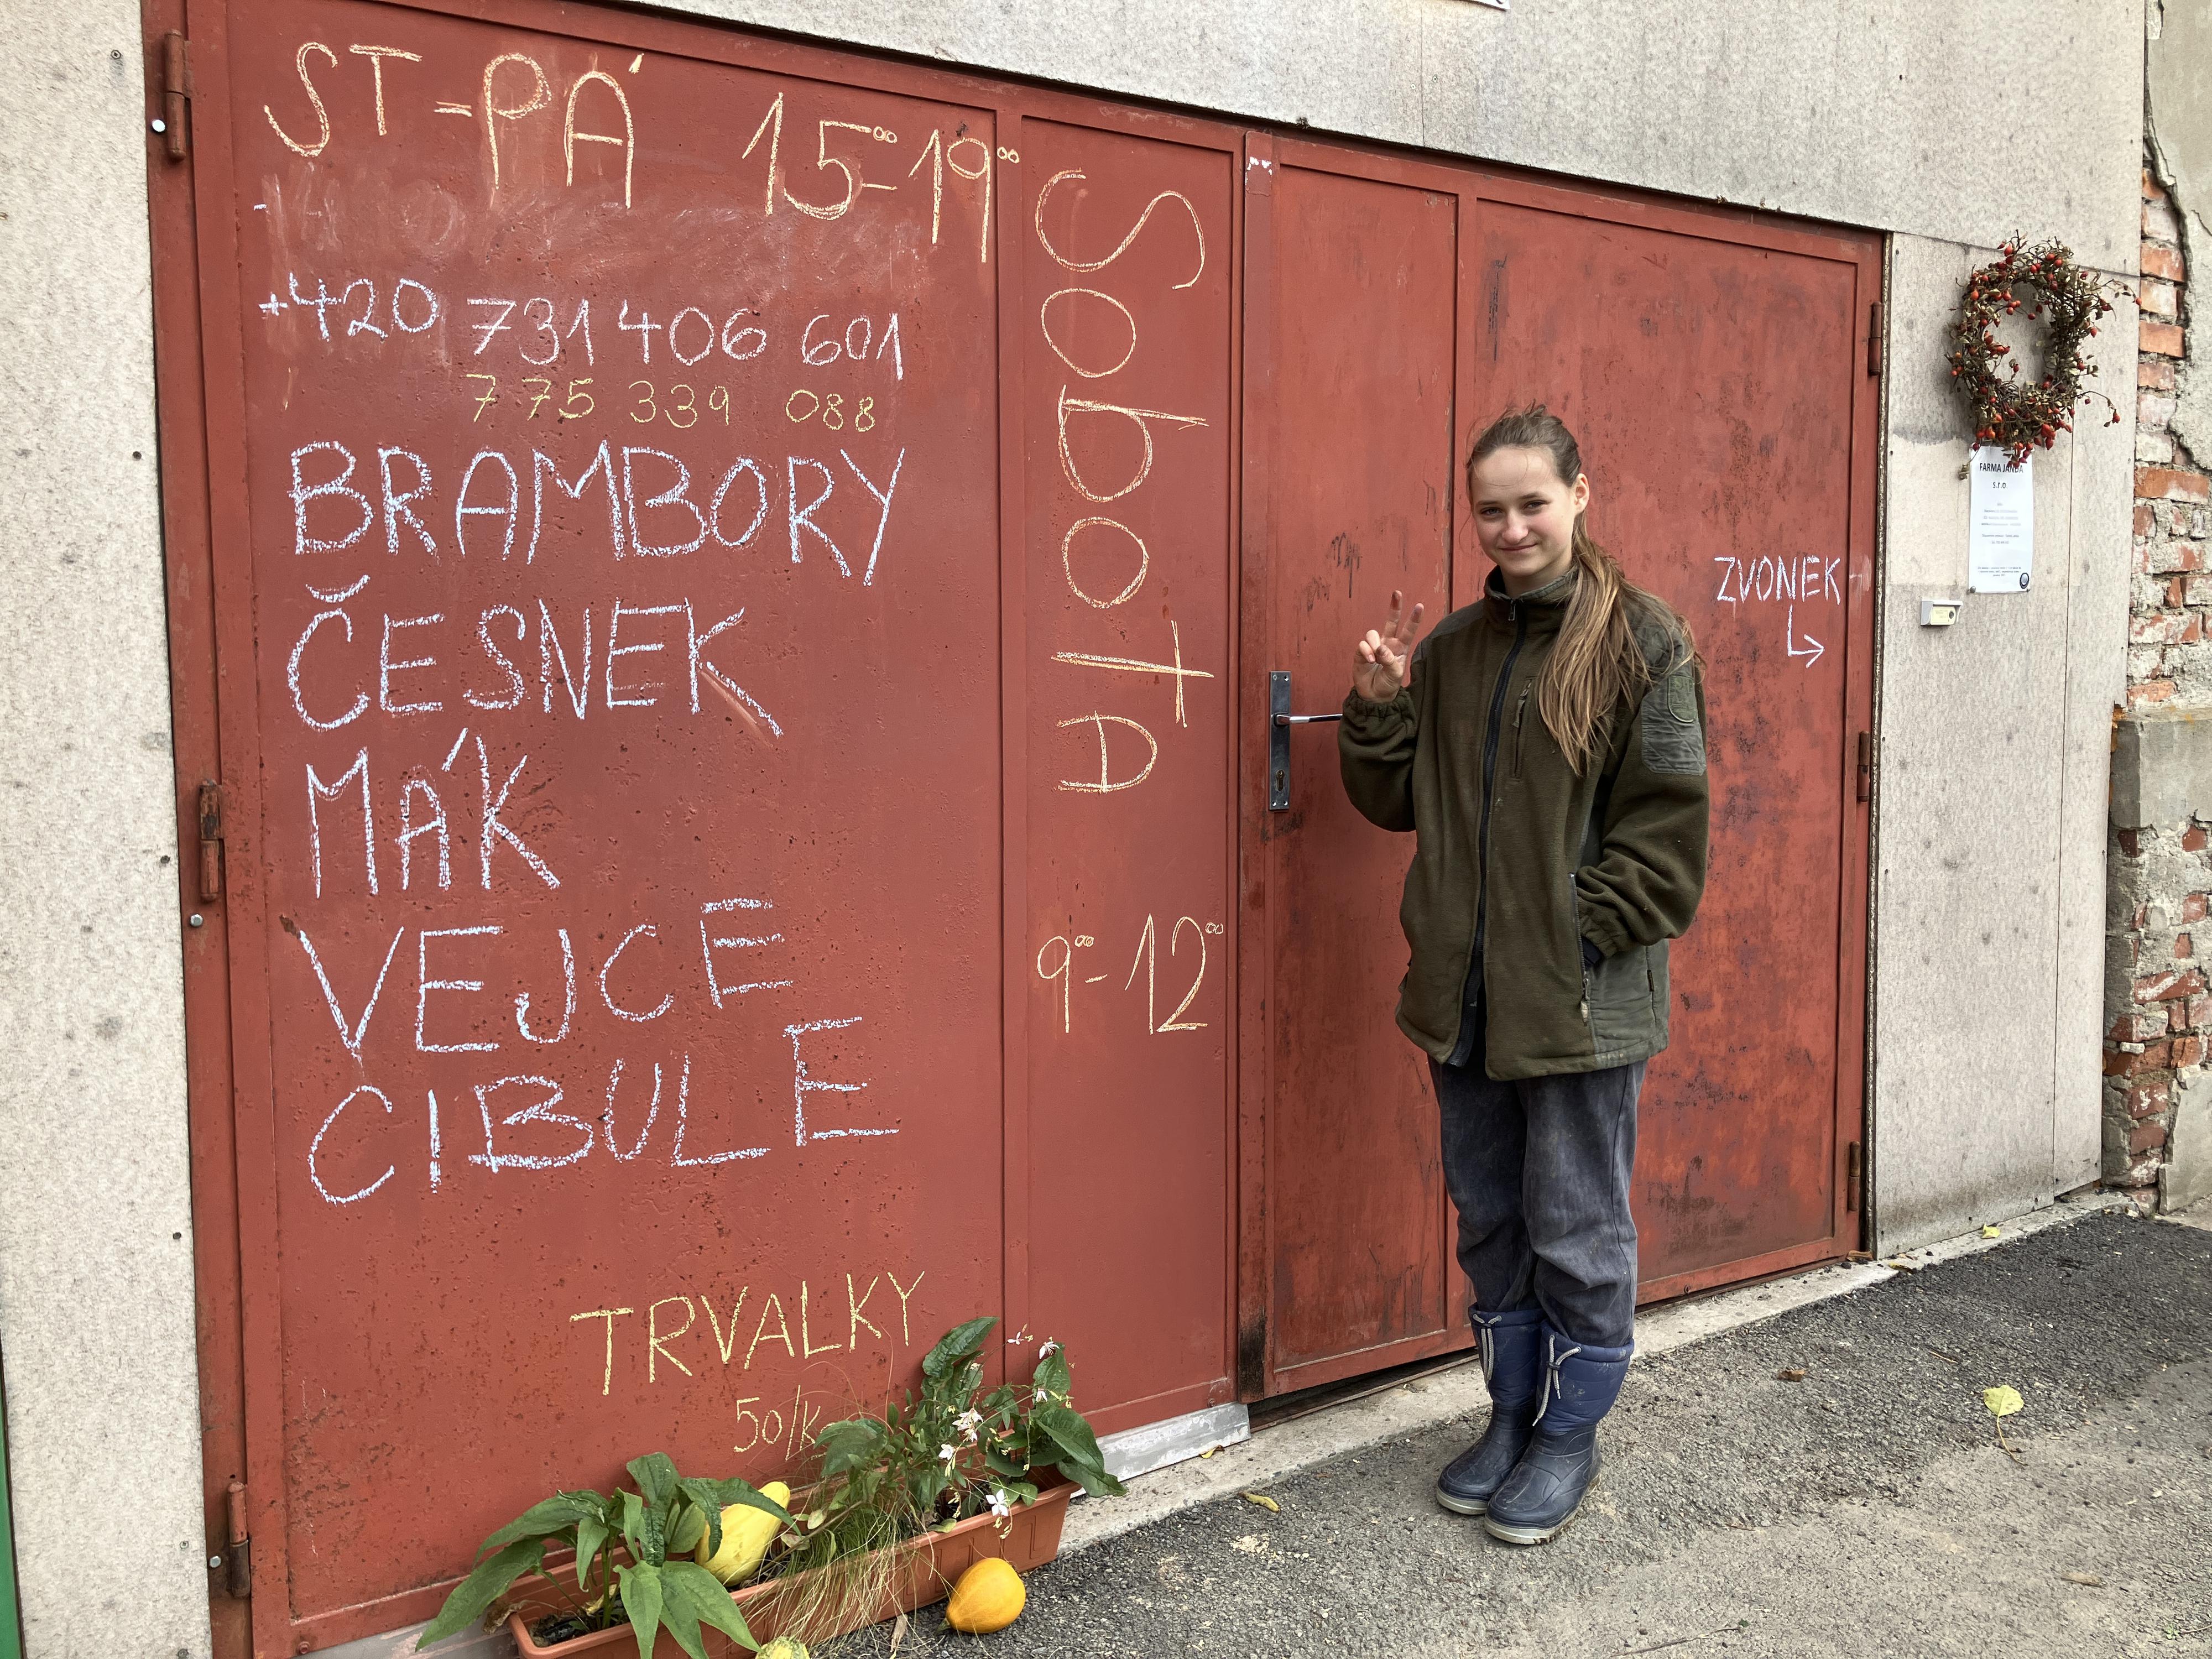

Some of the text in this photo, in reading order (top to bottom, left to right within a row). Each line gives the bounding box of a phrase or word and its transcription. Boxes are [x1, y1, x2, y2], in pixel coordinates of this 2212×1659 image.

[259, 272, 904, 380] +420 731 406 601
[628, 380, 729, 429] 339
[785, 389, 876, 432] 088
[1979, 462, 2001, 472] FARMA
[289, 440, 906, 587] BRAMBORY
[1714, 555, 1841, 605] ZVONEK
[287, 575, 784, 737] ČESNEK
[306, 728, 561, 899] MÁK
[299, 898, 794, 1059] VEJCE
[306, 1016, 900, 1207] CIBULE
[570, 1271, 926, 1396] TRVALKY
